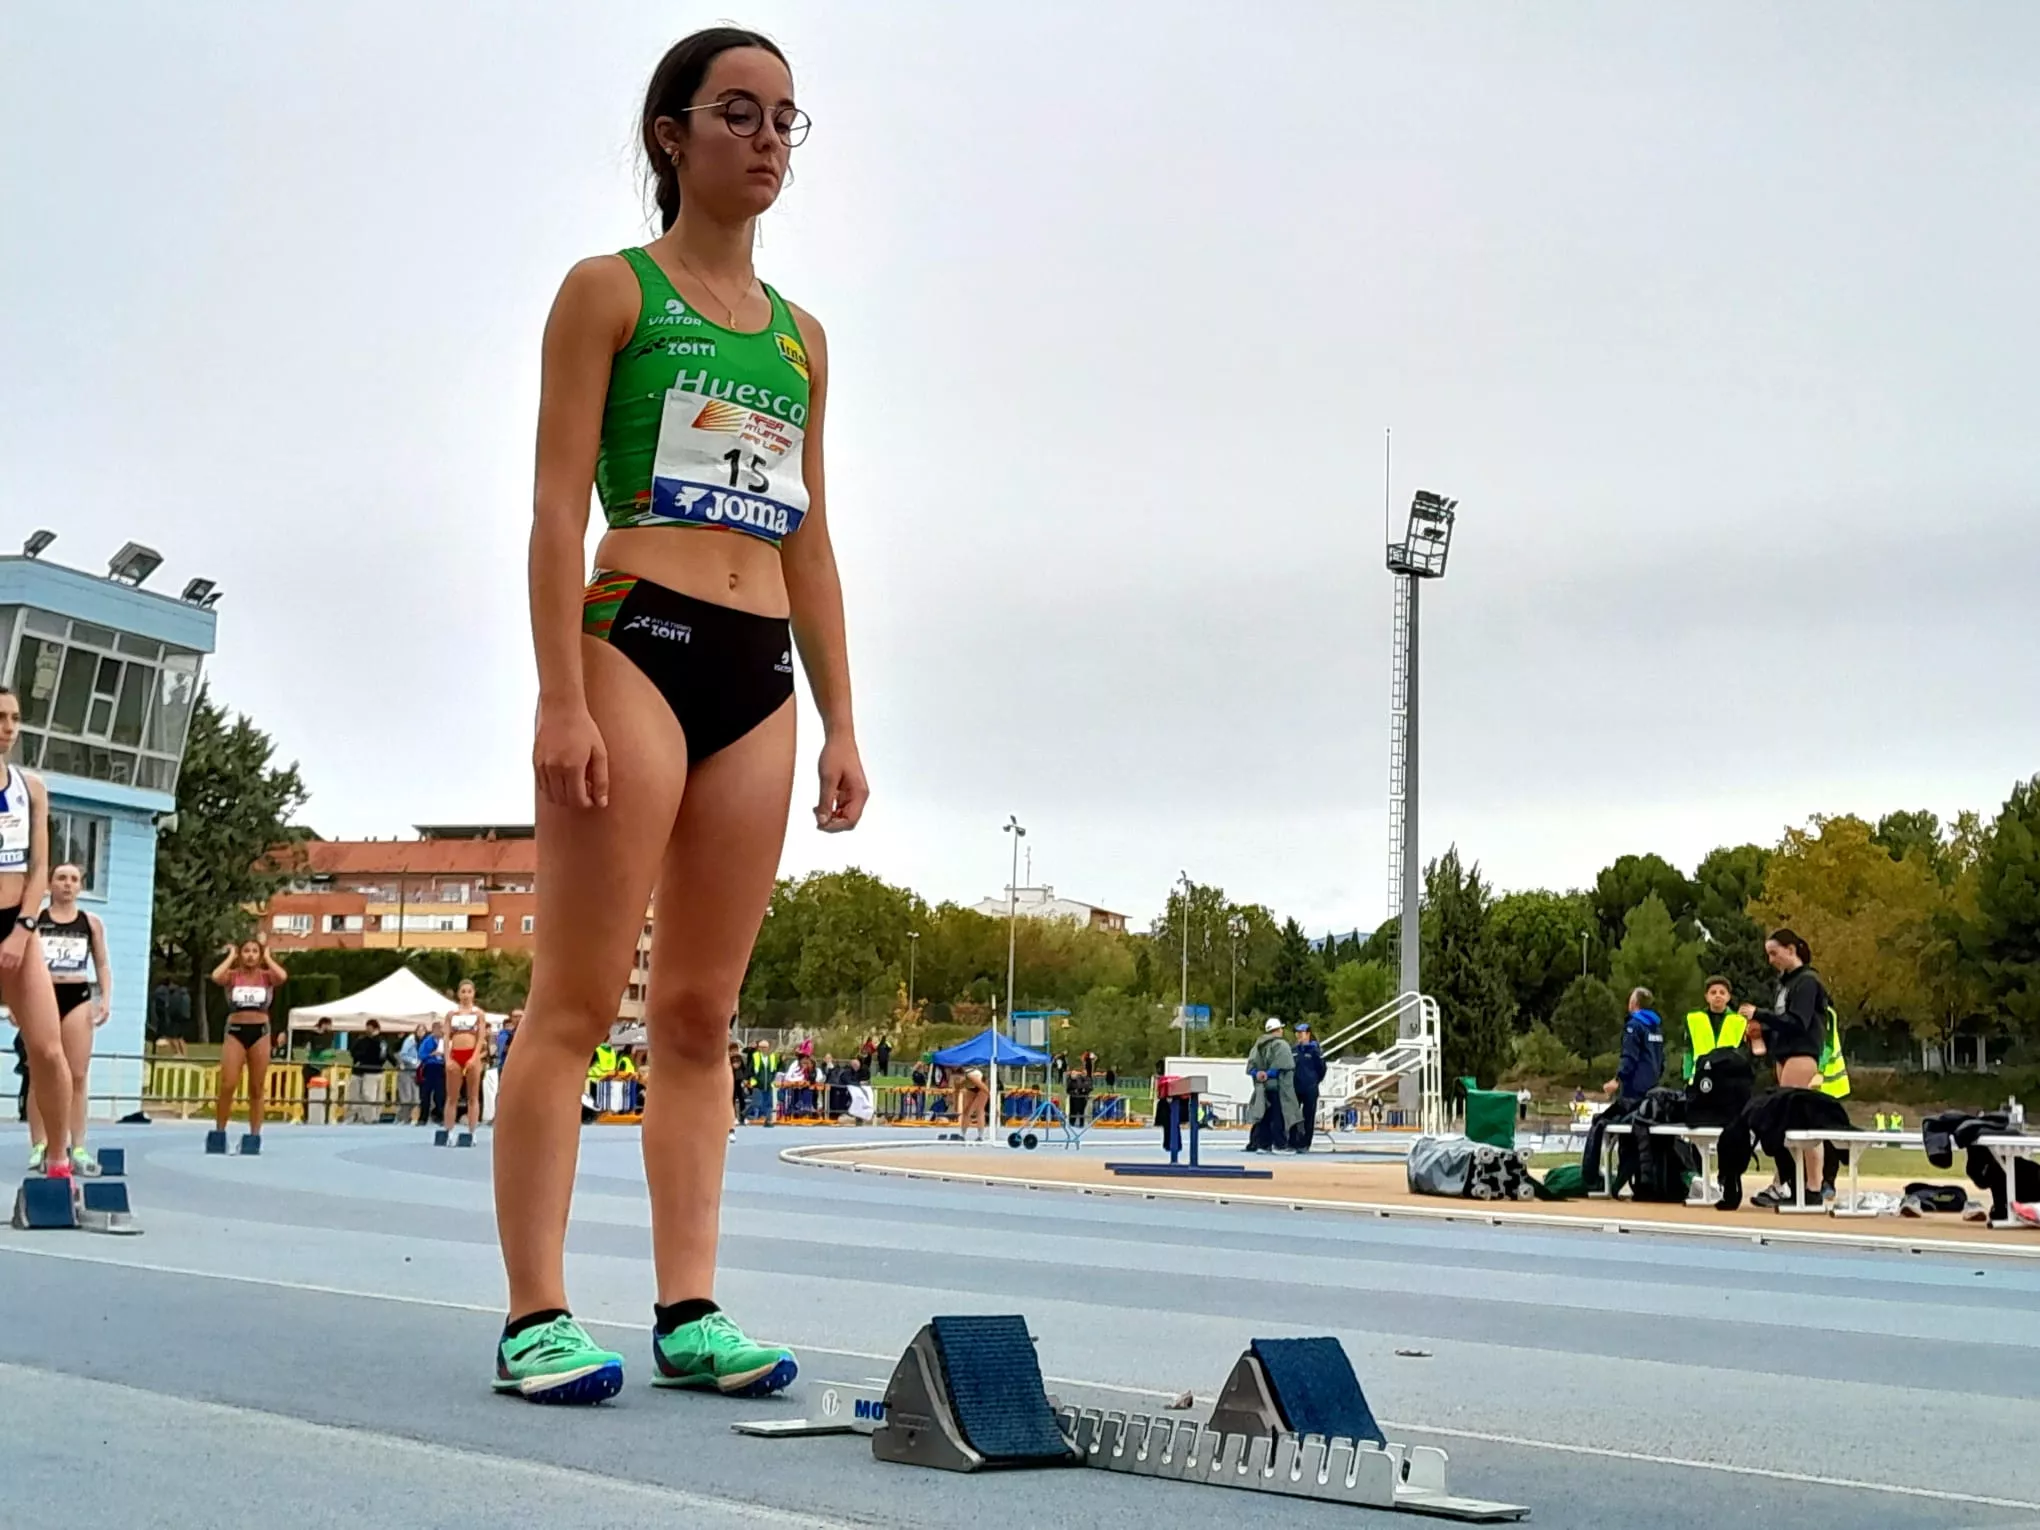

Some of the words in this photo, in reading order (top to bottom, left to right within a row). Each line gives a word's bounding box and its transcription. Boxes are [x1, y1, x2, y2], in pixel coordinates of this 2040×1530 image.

[648, 315, 702, 326] VIATOR
[667, 342, 716, 357] ZOITI
[674, 368, 806, 426] Huesca
[723, 448, 770, 494] 15
[650, 624, 691, 644] ZOITI
